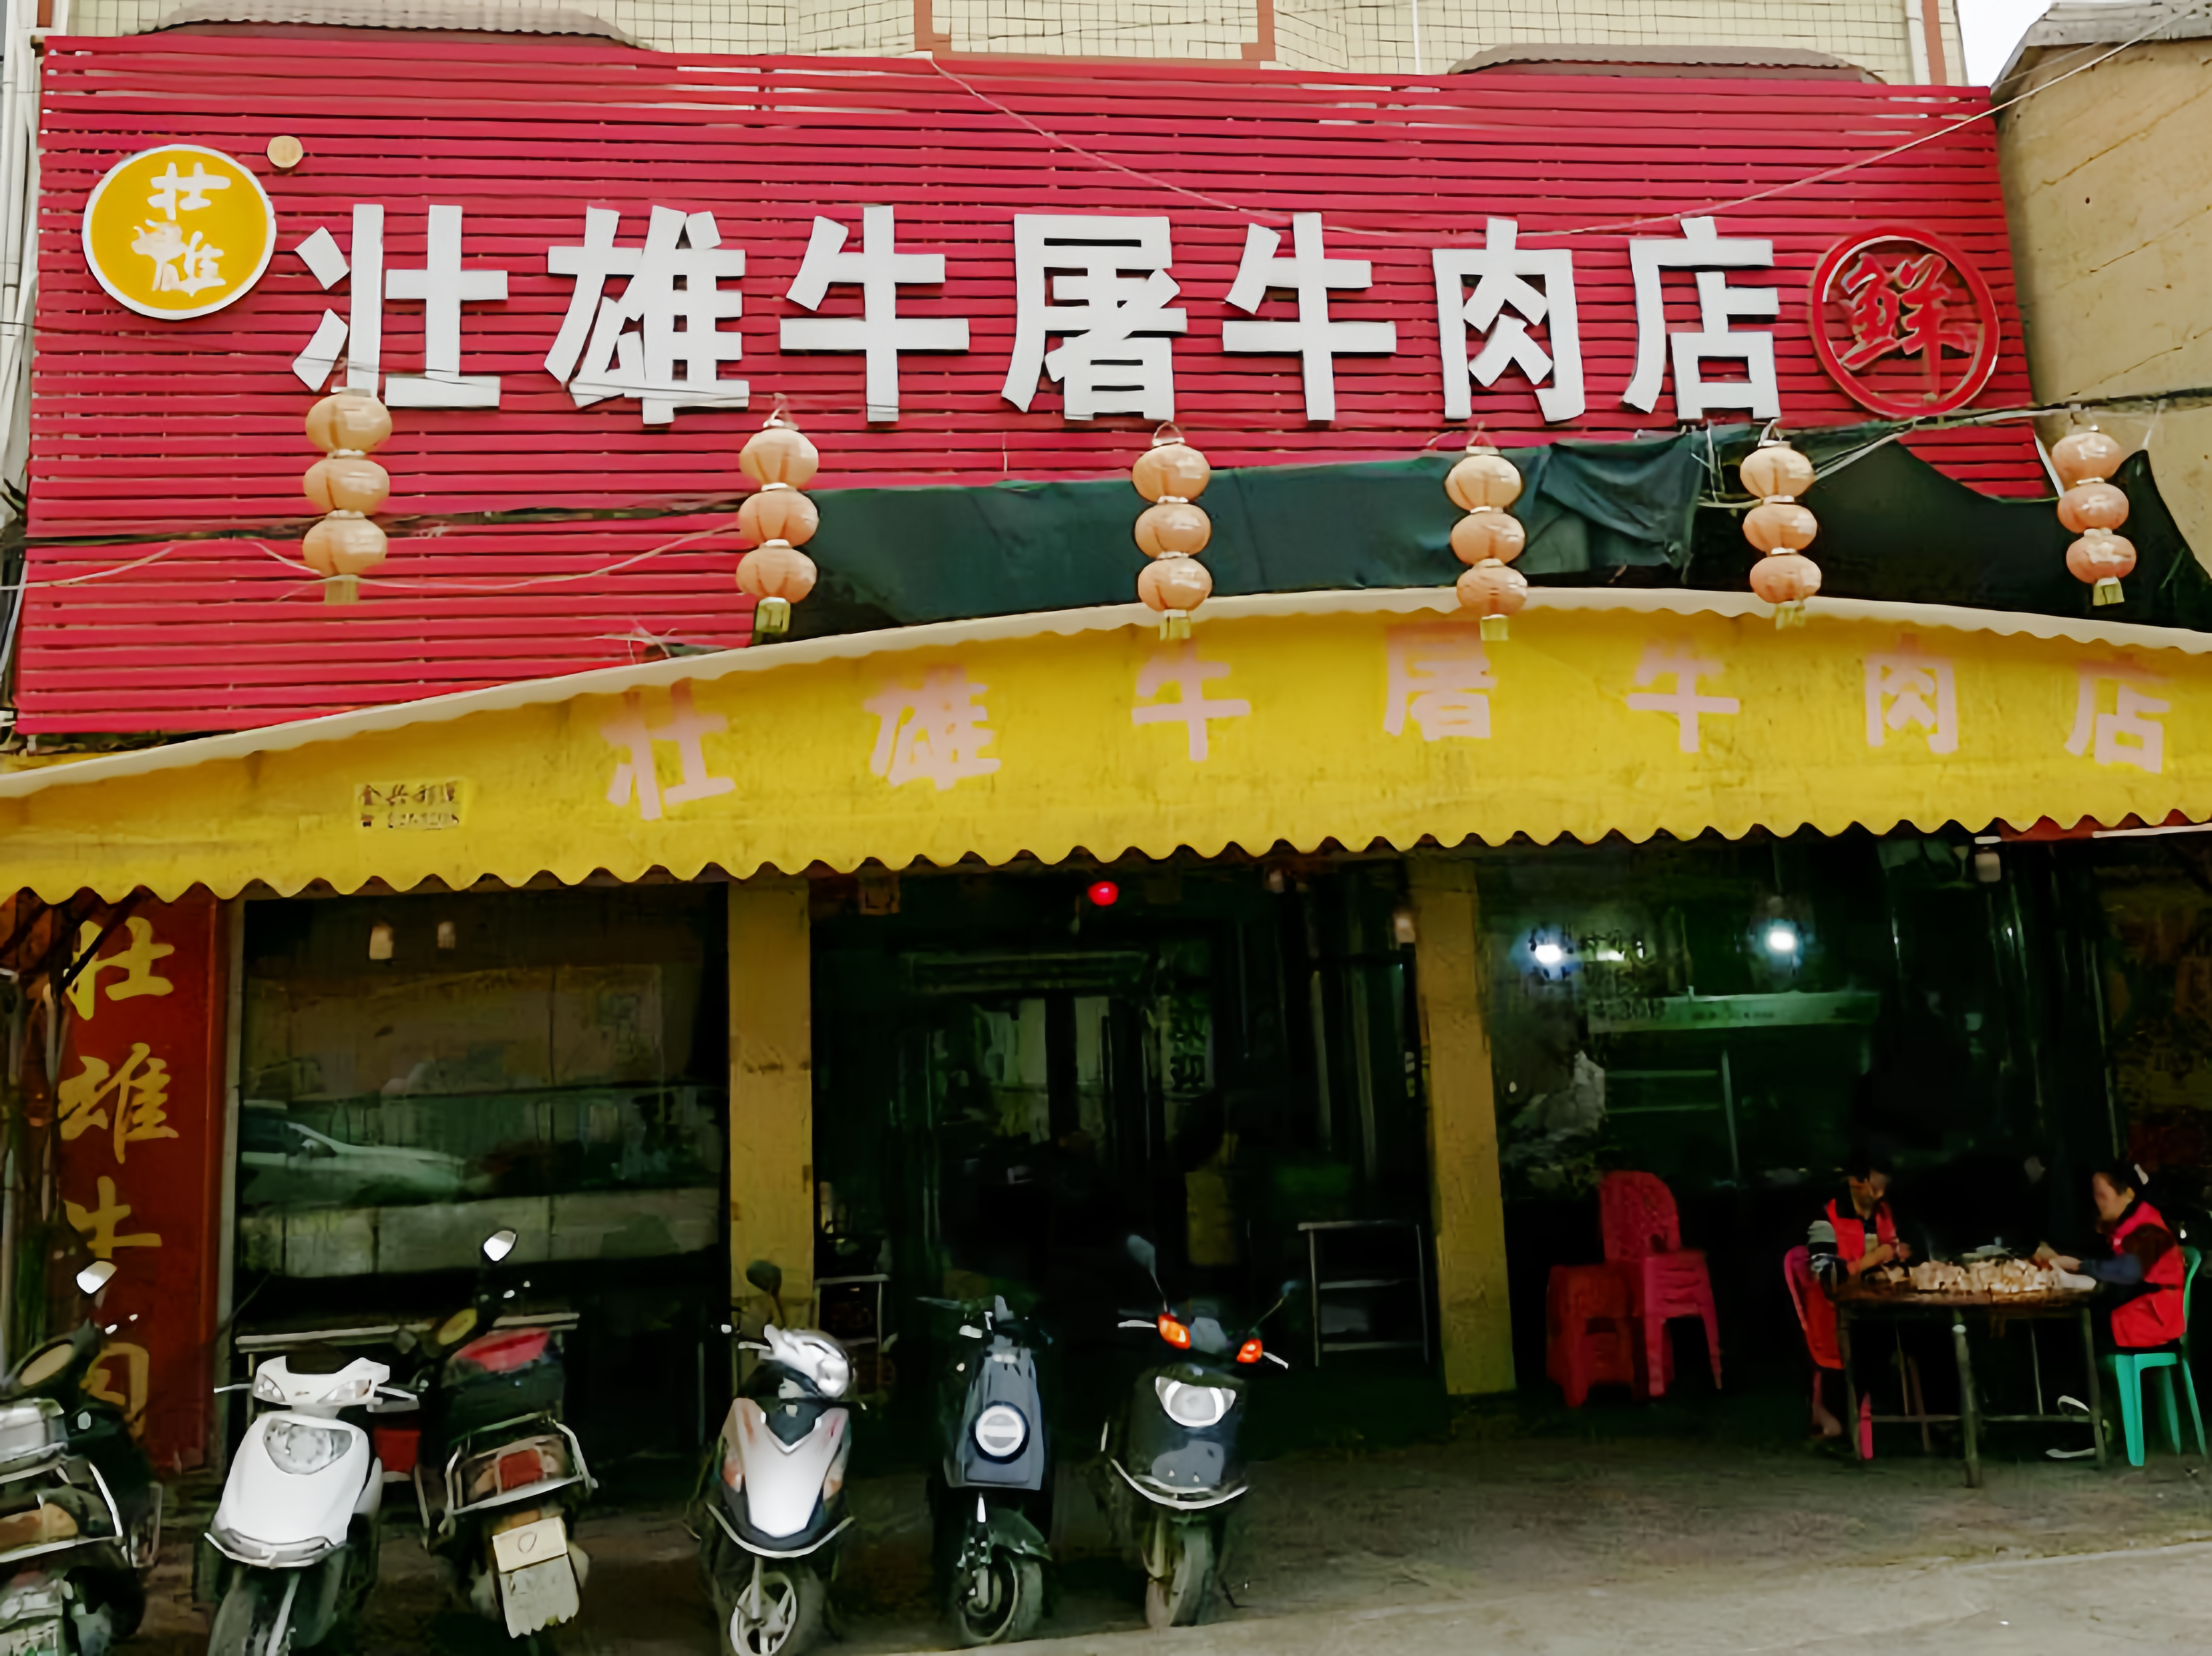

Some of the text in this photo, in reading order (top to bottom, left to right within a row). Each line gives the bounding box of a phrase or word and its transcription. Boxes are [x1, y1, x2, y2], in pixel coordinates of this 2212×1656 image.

[292, 204, 1781, 425] 壮雄牛屠牛肉店
[599, 621, 2172, 821] 壮雄牛屠牛肉店
